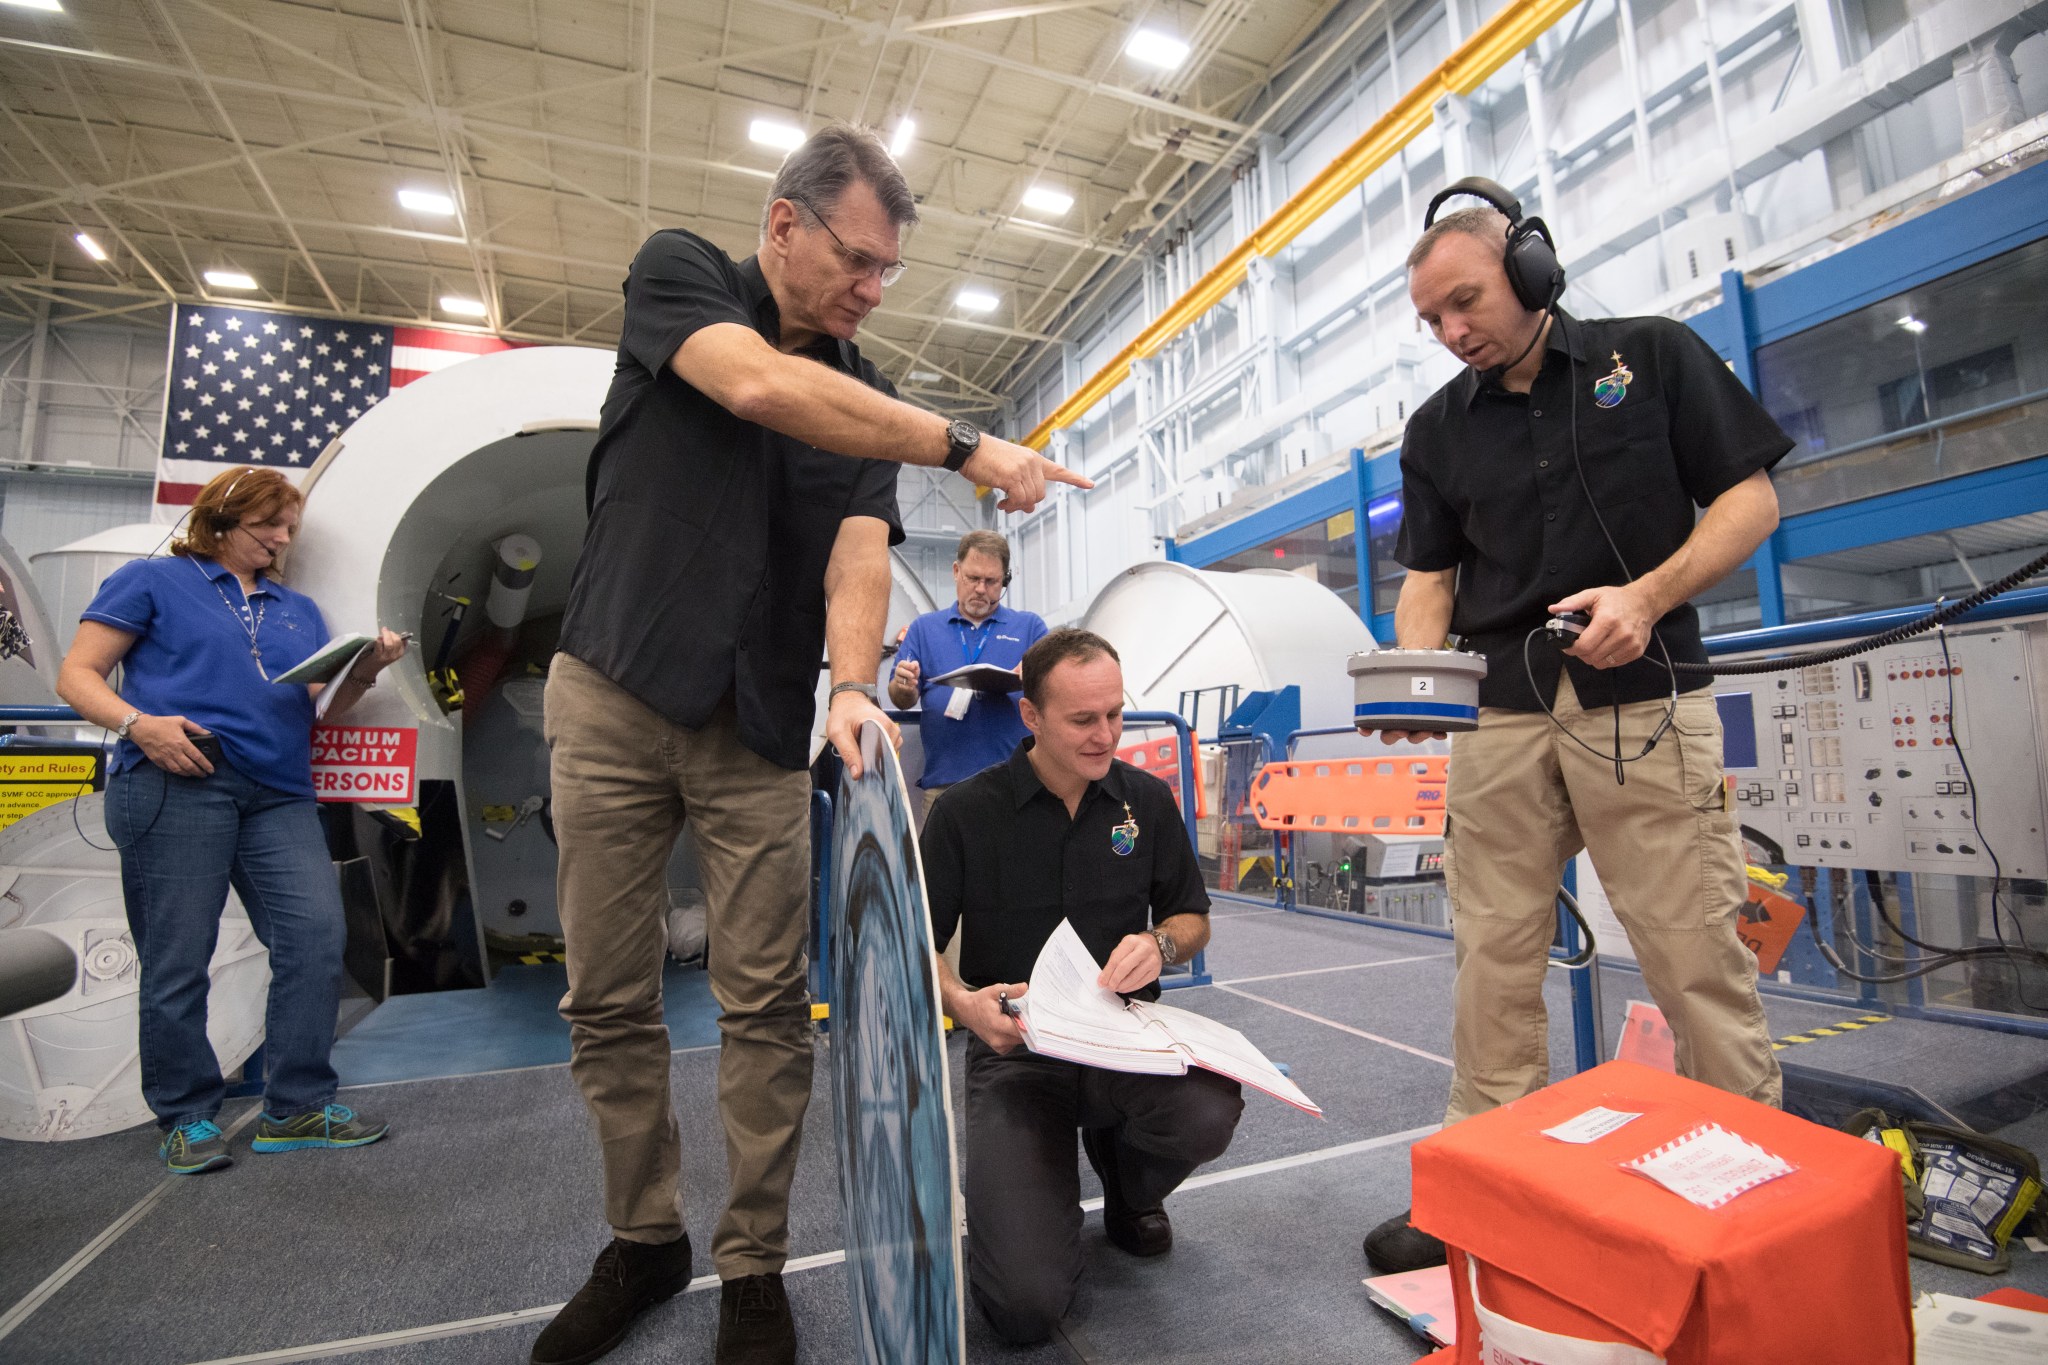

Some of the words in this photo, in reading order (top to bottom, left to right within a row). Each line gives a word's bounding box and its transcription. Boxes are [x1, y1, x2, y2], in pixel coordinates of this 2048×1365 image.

[1419, 681, 1427, 691] 2
[314, 730, 401, 746] XIMUM
[311, 747, 398, 762] PACITY
[0, 763, 15, 776] ty
[19, 763, 45, 773] and
[48, 763, 87, 773] Rules
[311, 771, 405, 791] ERSONS
[1966, 1152, 1990, 1165] DEVICE
